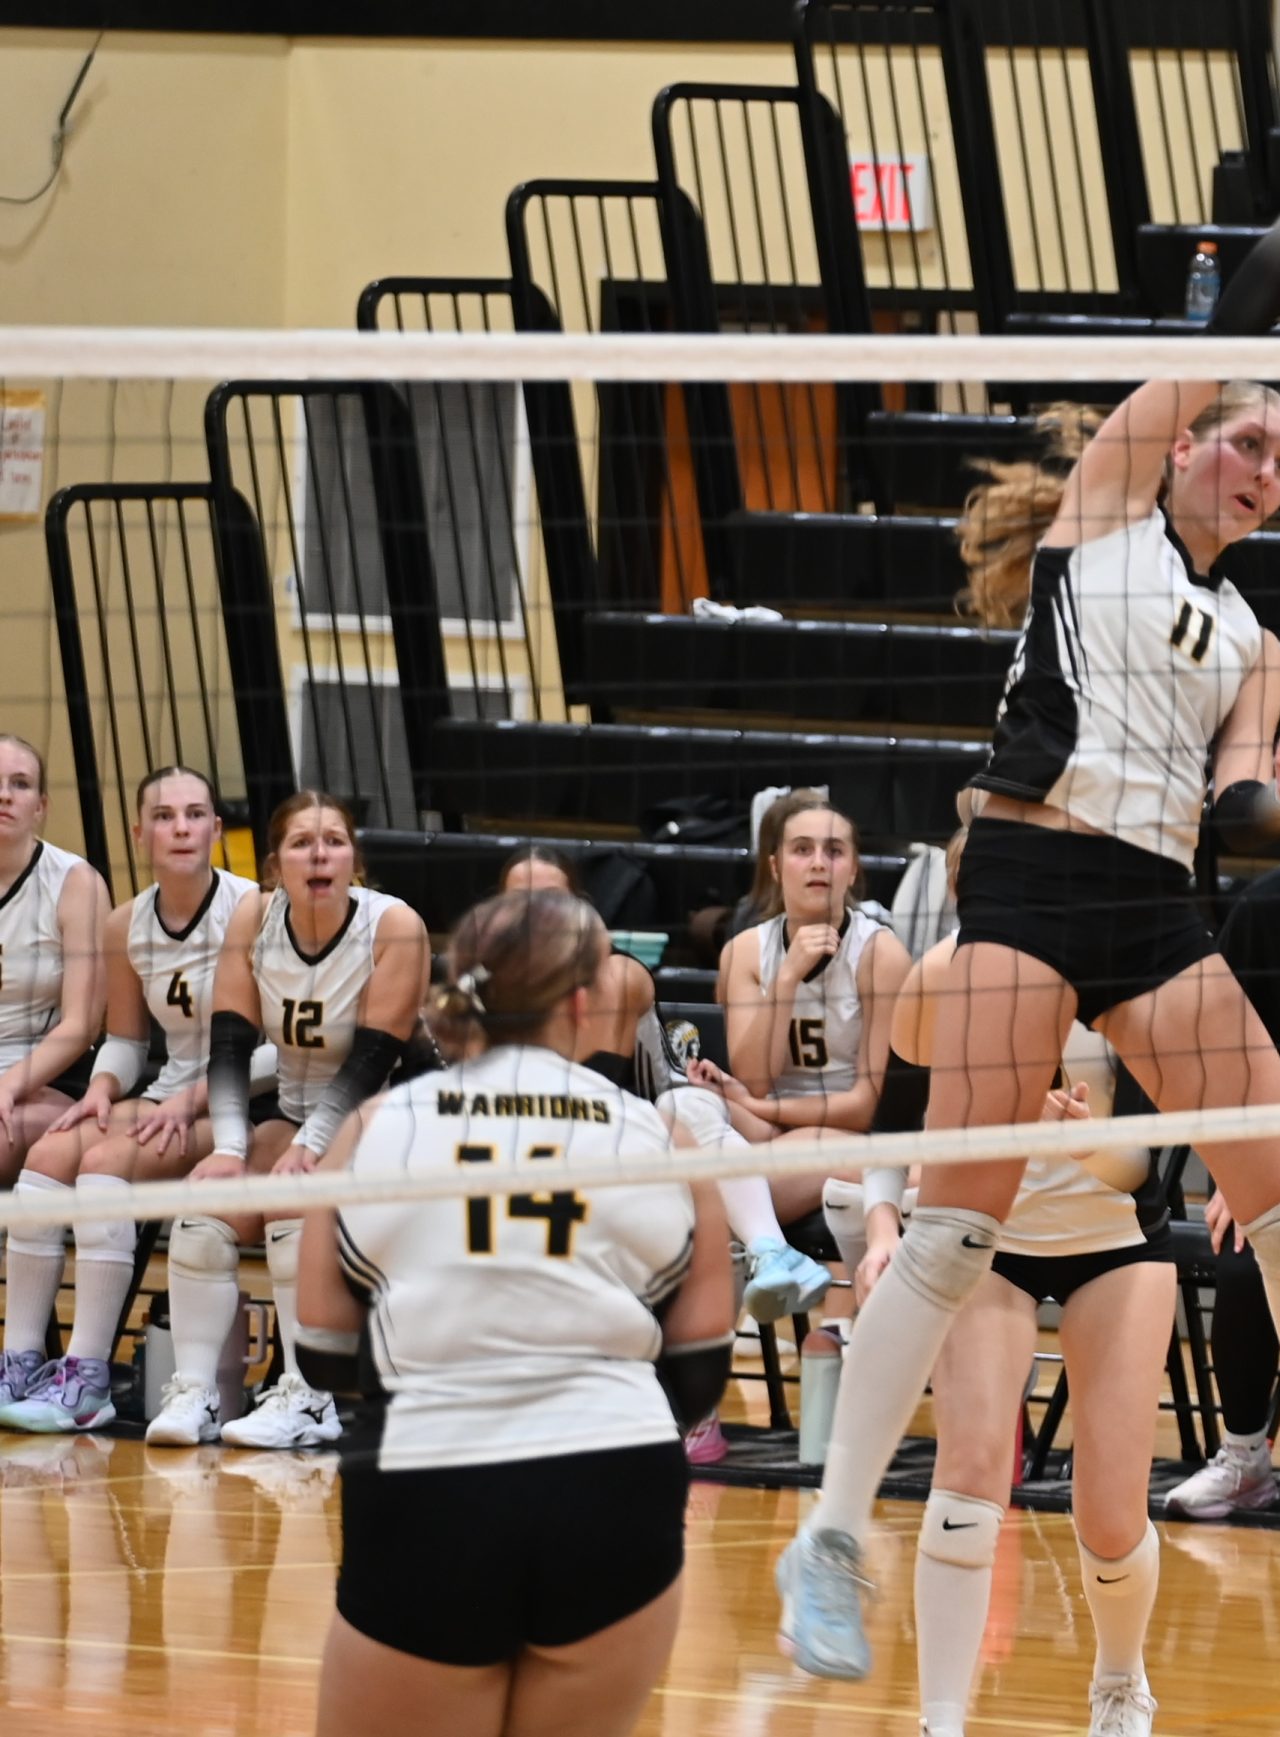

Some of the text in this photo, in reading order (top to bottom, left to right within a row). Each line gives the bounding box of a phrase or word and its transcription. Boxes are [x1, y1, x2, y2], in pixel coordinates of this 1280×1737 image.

[850, 163, 914, 222] EXIT
[166, 970, 194, 1018] 4
[282, 998, 325, 1048] 12
[789, 1018, 828, 1067] 15
[437, 1090, 610, 1124] WARRIORS
[457, 1143, 589, 1258] 14
